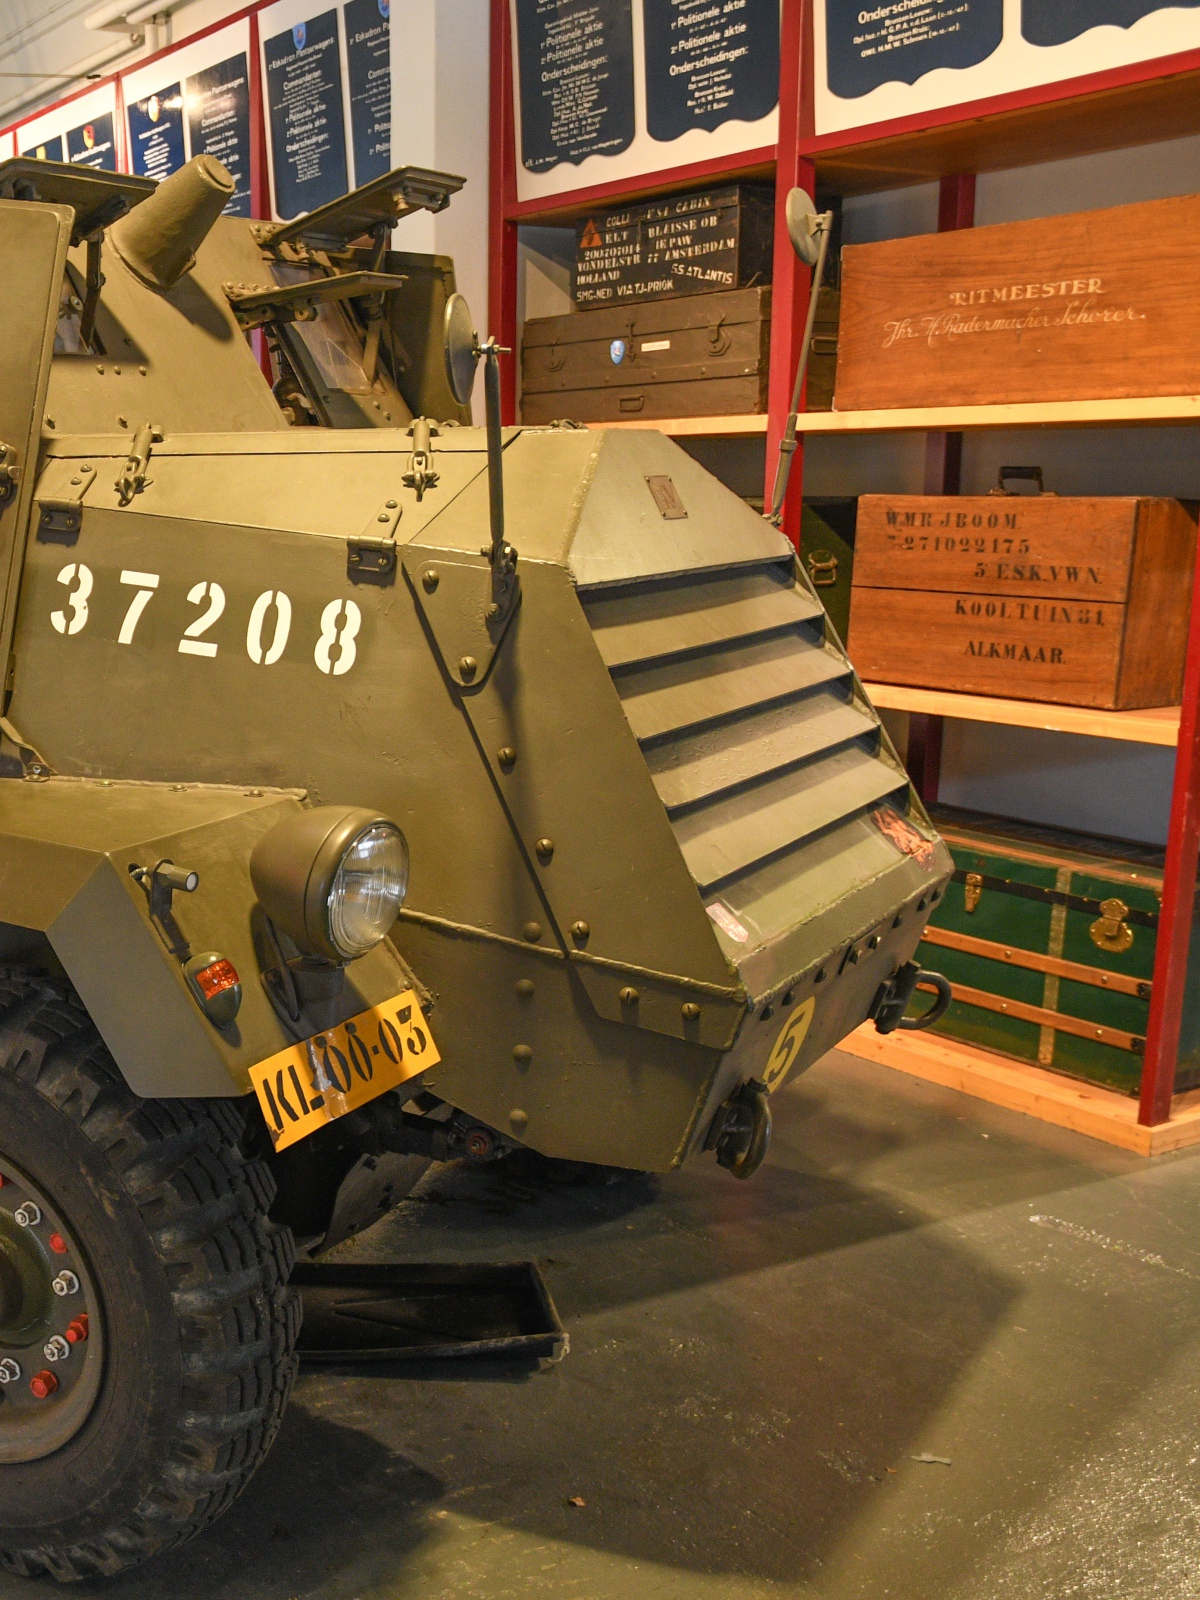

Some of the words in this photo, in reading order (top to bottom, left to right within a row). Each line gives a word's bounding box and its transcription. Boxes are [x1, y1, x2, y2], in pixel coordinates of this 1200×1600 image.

[677, 6, 720, 28] Politionele
[723, 0, 746, 14] aktie
[546, 28, 583, 48] Politionele
[584, 21, 604, 35] aktie
[678, 30, 721, 52] Politionele
[724, 22, 748, 38] aktie
[547, 44, 583, 62] Politionele
[585, 36, 604, 49] aktie
[669, 46, 749, 76] Onderscheidingen:
[541, 55, 608, 82] Onderscheidingen:
[605, 212, 630, 228] COLLI
[675, 196, 711, 213] CABIN
[648, 219, 697, 239] BLAISSE
[577, 253, 641, 273] VONDELSTR
[664, 237, 736, 261] AMSTERDAM
[576, 270, 621, 286] HOLLAND
[617, 283, 634, 296] VIA
[685, 266, 734, 285] ATLANTIS
[949, 277, 1107, 307] RITMEESTER
[50, 564, 362, 676] 37208
[767, 1011, 806, 1085] 5
